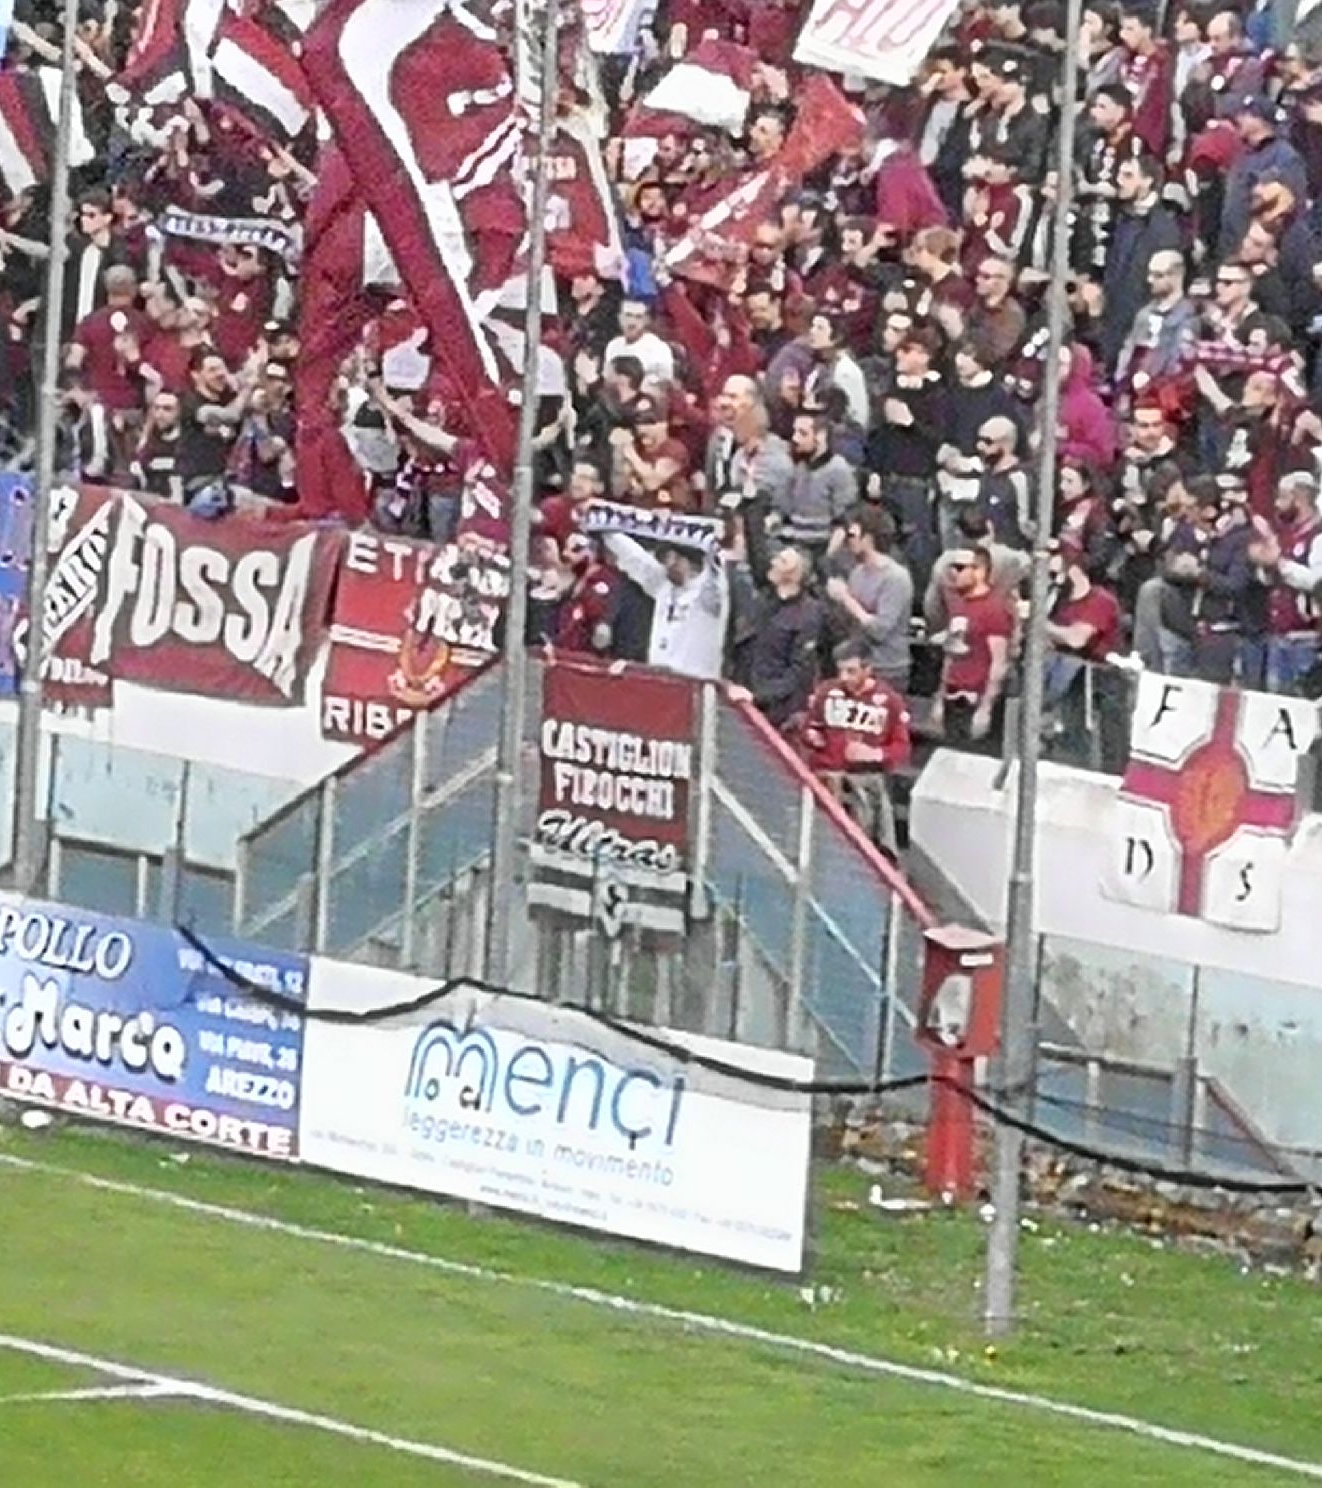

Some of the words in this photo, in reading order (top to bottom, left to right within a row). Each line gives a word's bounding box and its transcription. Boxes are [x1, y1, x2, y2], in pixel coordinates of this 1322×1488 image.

[90, 494, 317, 699] FOSSA
[541, 718, 693, 780] CASTIGLION
[9, 1068, 55, 1100] DA
[62, 1083, 155, 1125] ALTA
[165, 1101, 293, 1155] CORTE
[206, 1064, 296, 1110] AREZZO
